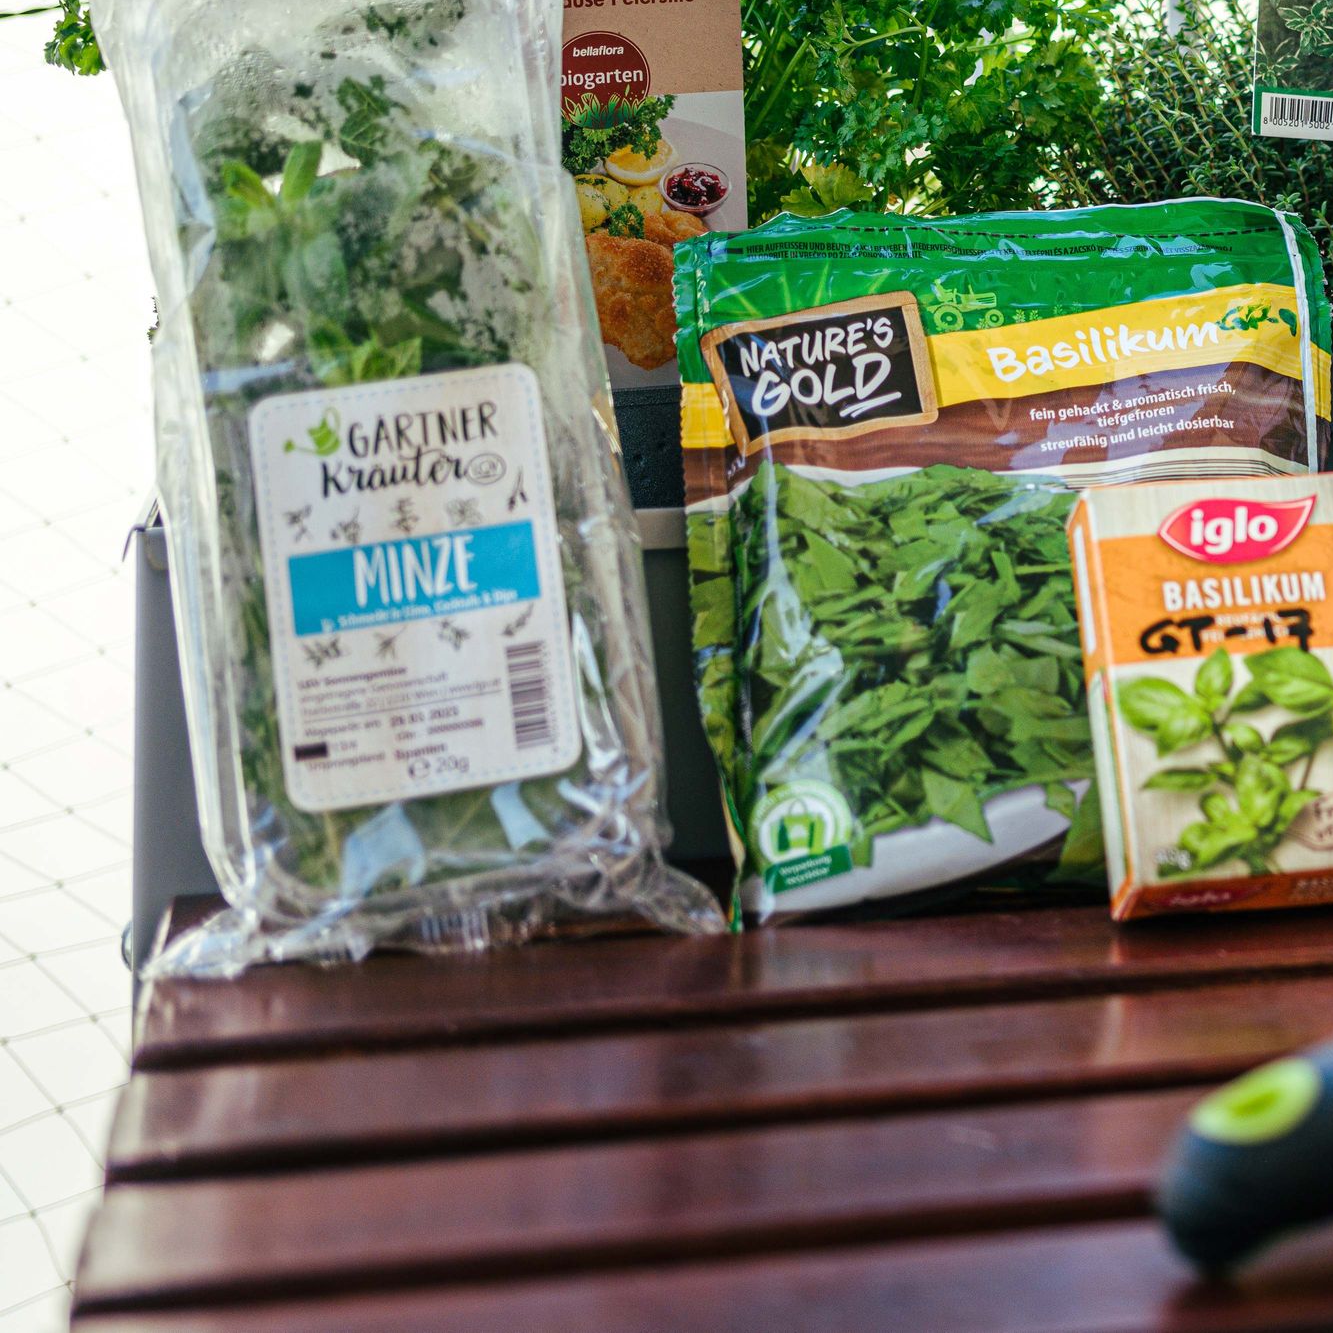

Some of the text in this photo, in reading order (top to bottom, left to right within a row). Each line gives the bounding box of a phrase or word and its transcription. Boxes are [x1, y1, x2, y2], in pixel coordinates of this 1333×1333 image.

[572, 45, 625, 58] bellaflora
[809, 242, 826, 251] UND
[740, 315, 894, 377] NATURE'S
[987, 320, 1219, 383] Basilikum
[751, 353, 892, 418] GOLD
[1030, 381, 1237, 421] fein gehackt & aromatisch frisch,
[1040, 415, 1235, 453] streufähig und leicht dosierbar
[1097, 405, 1175, 428] tiefgefroren
[1189, 506, 1279, 555] iglo
[353, 534, 479, 609] MINZE
[1162, 571, 1326, 612] BASILIKUM
